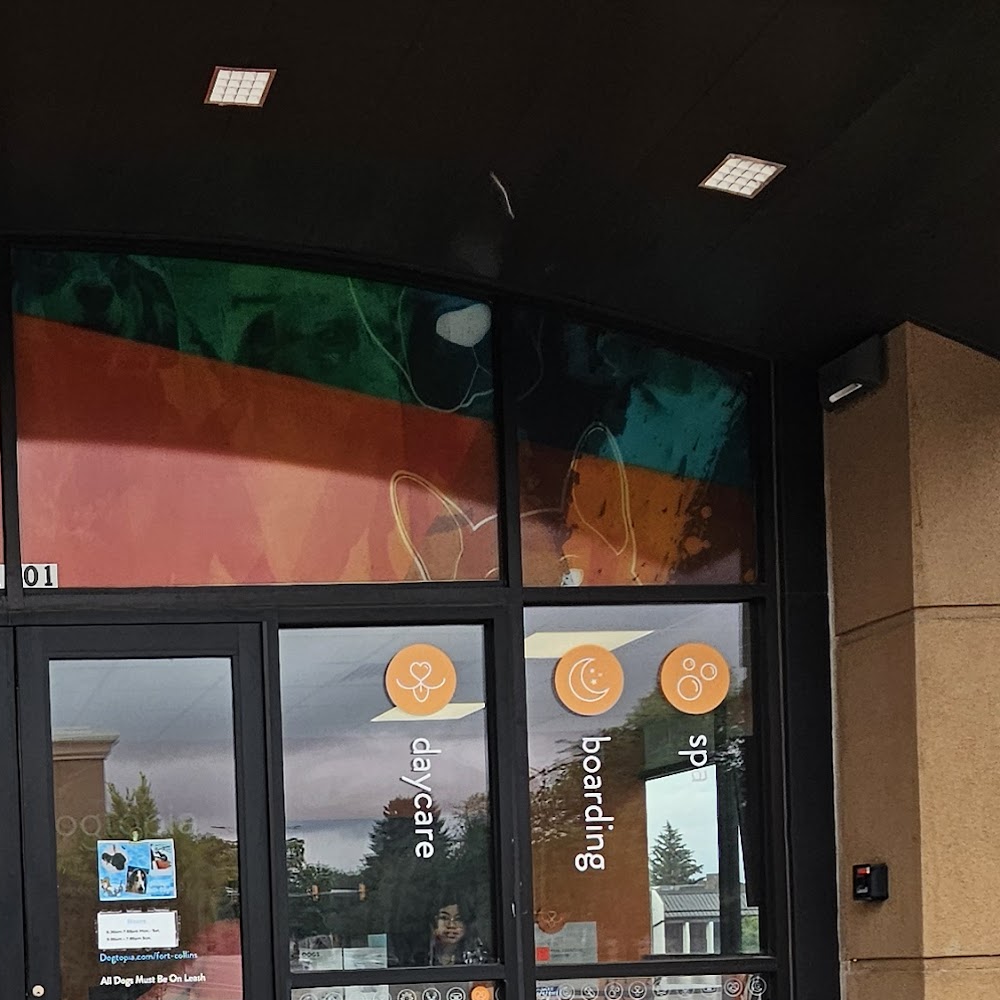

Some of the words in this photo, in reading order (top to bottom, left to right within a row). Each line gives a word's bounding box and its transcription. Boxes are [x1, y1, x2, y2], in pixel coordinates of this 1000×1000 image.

[23, 565, 53, 587] 01
[401, 737, 442, 859] daycare
[574, 736, 615, 872] boarding
[100, 951, 198, 964] Dogtopia.com/fort-collins
[100, 976, 112, 986] All
[113, 976, 134, 987] Dogs
[135, 975, 155, 984] Must
[157, 974, 168, 983] Be
[169, 974, 182, 983] On
[184, 973, 206, 982] Leash
